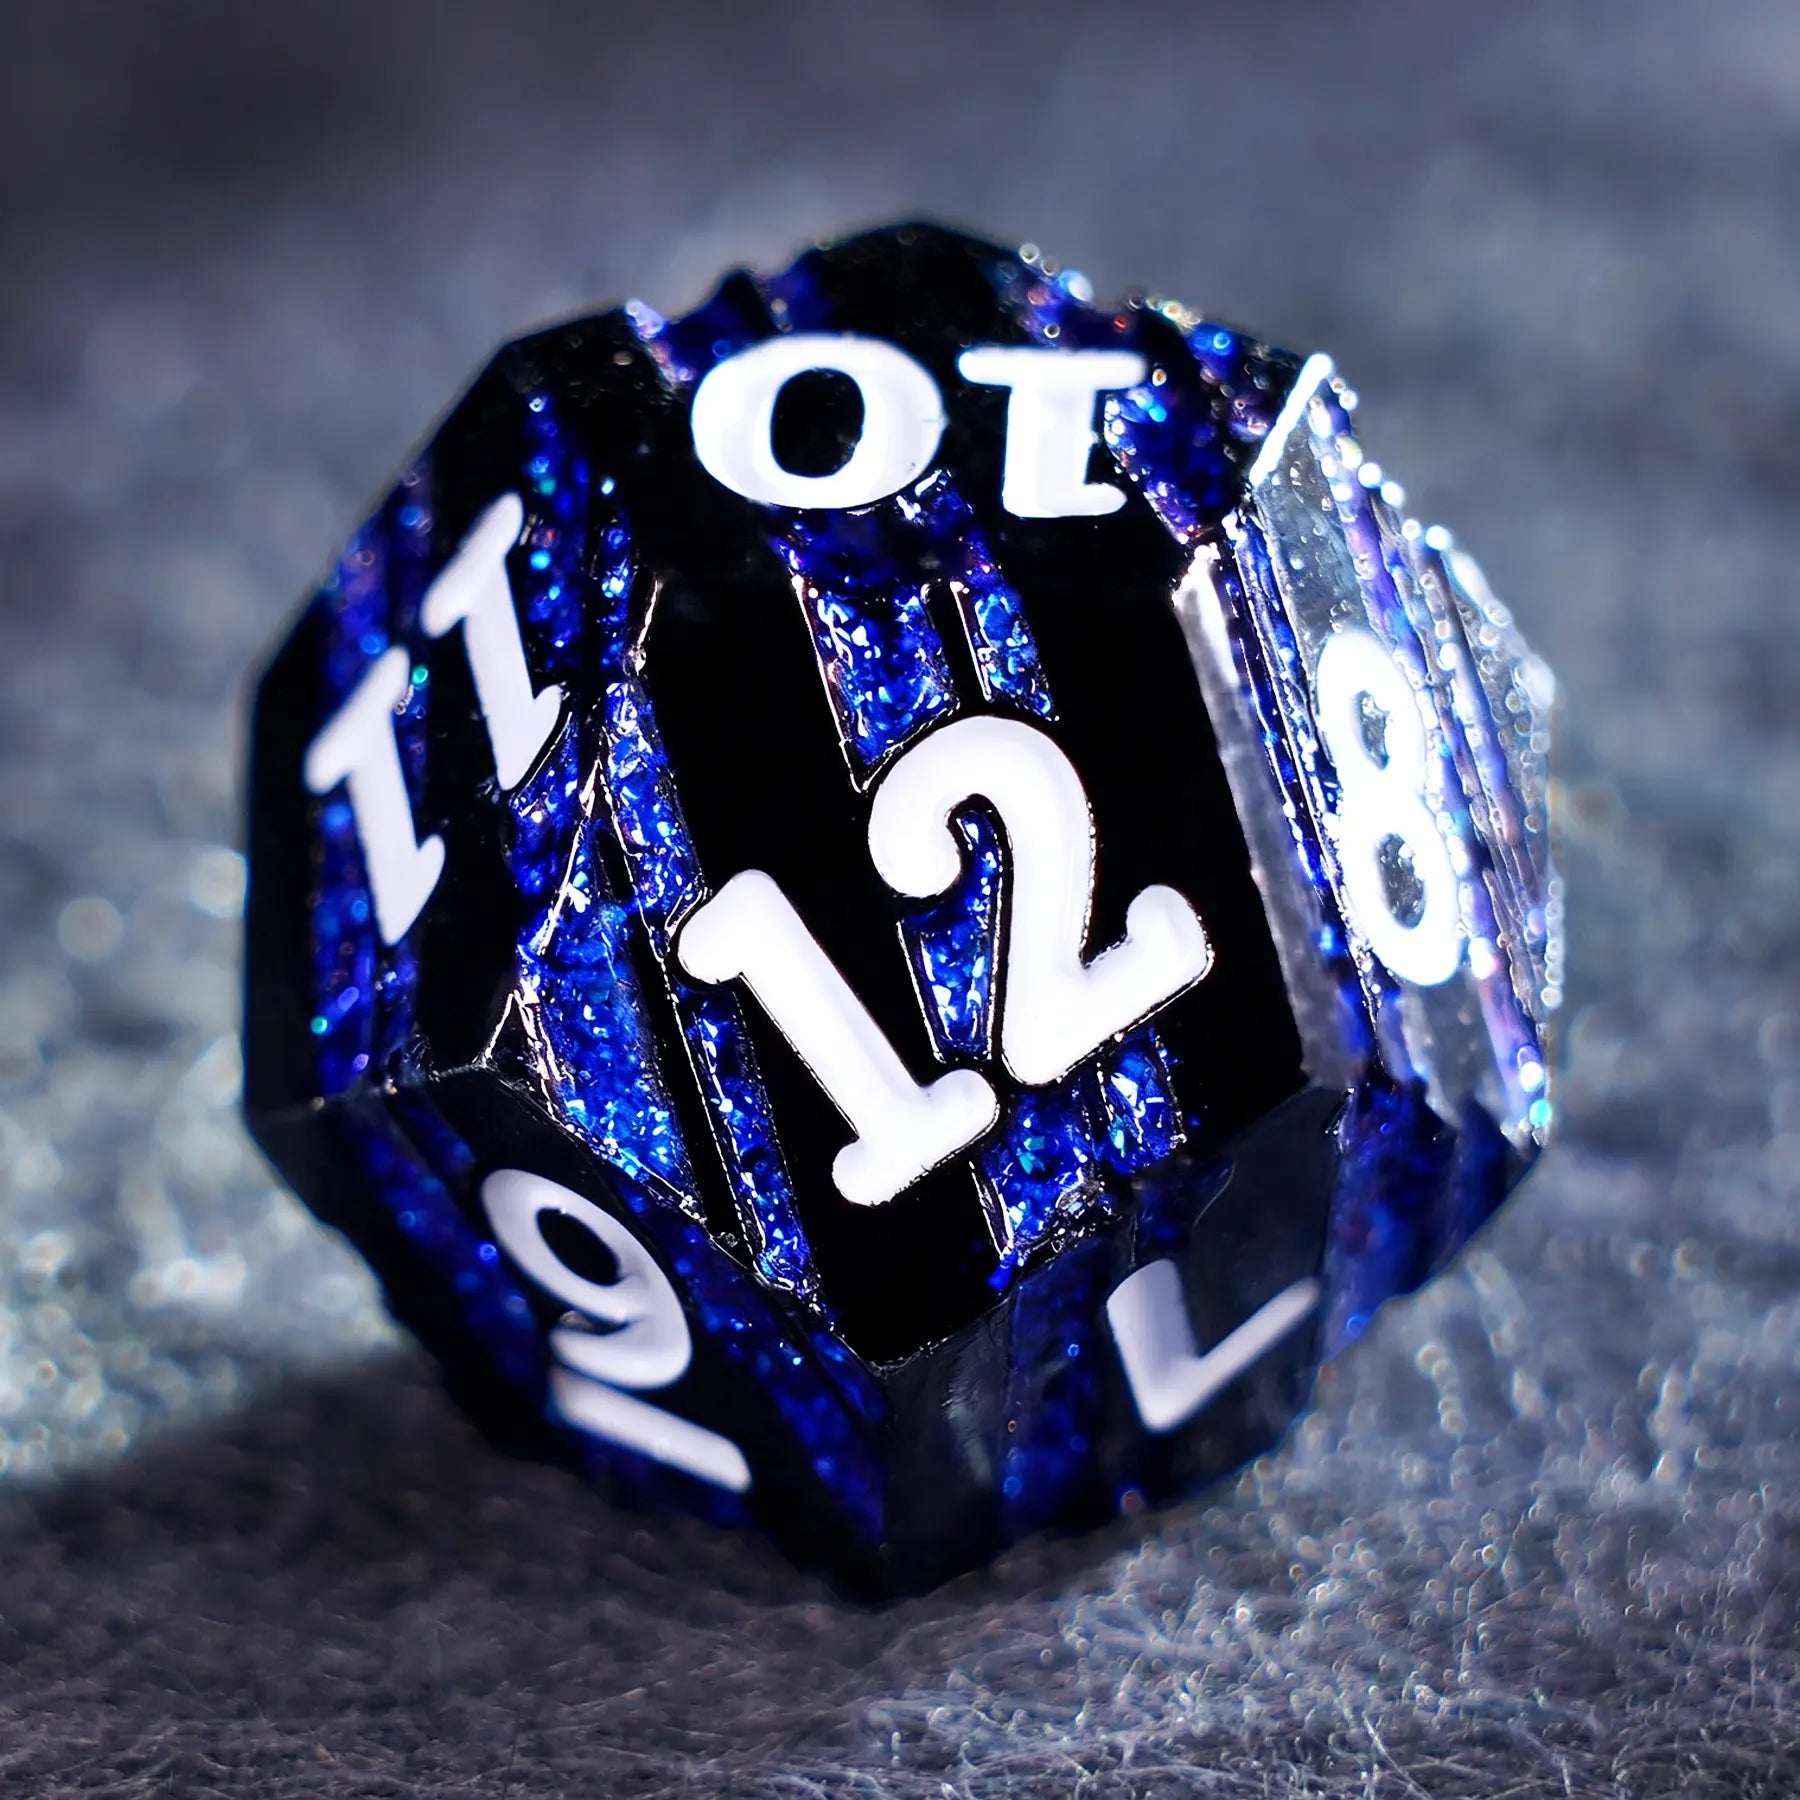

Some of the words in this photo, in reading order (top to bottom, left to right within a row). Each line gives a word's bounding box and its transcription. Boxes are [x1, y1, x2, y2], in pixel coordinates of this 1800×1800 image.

[690, 334, 1147, 519] 10
[305, 493, 566, 946] 11
[1317, 629, 1461, 985] 8
[677, 715, 1215, 1207] 12
[1106, 1257, 1318, 1433] 7
